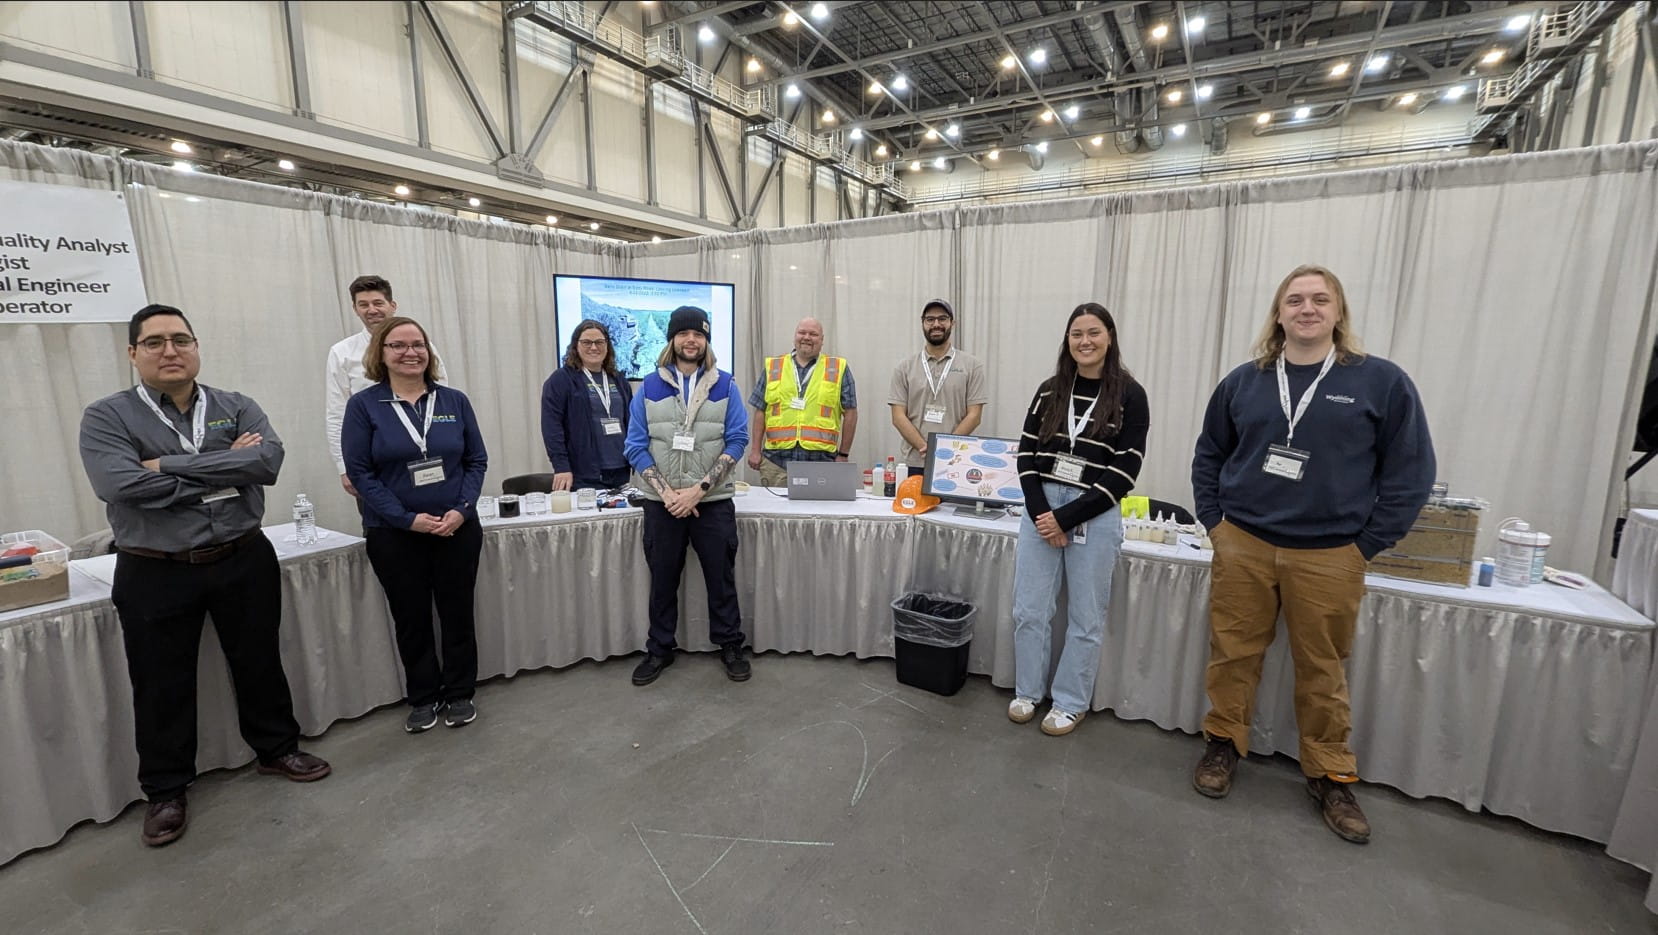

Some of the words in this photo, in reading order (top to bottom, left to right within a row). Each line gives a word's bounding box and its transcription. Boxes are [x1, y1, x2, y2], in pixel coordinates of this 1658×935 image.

[0, 232, 50, 252] ality
[56, 236, 130, 256] Analyst
[16, 277, 111, 295] Engineer
[431, 415, 457, 423] EGLE
